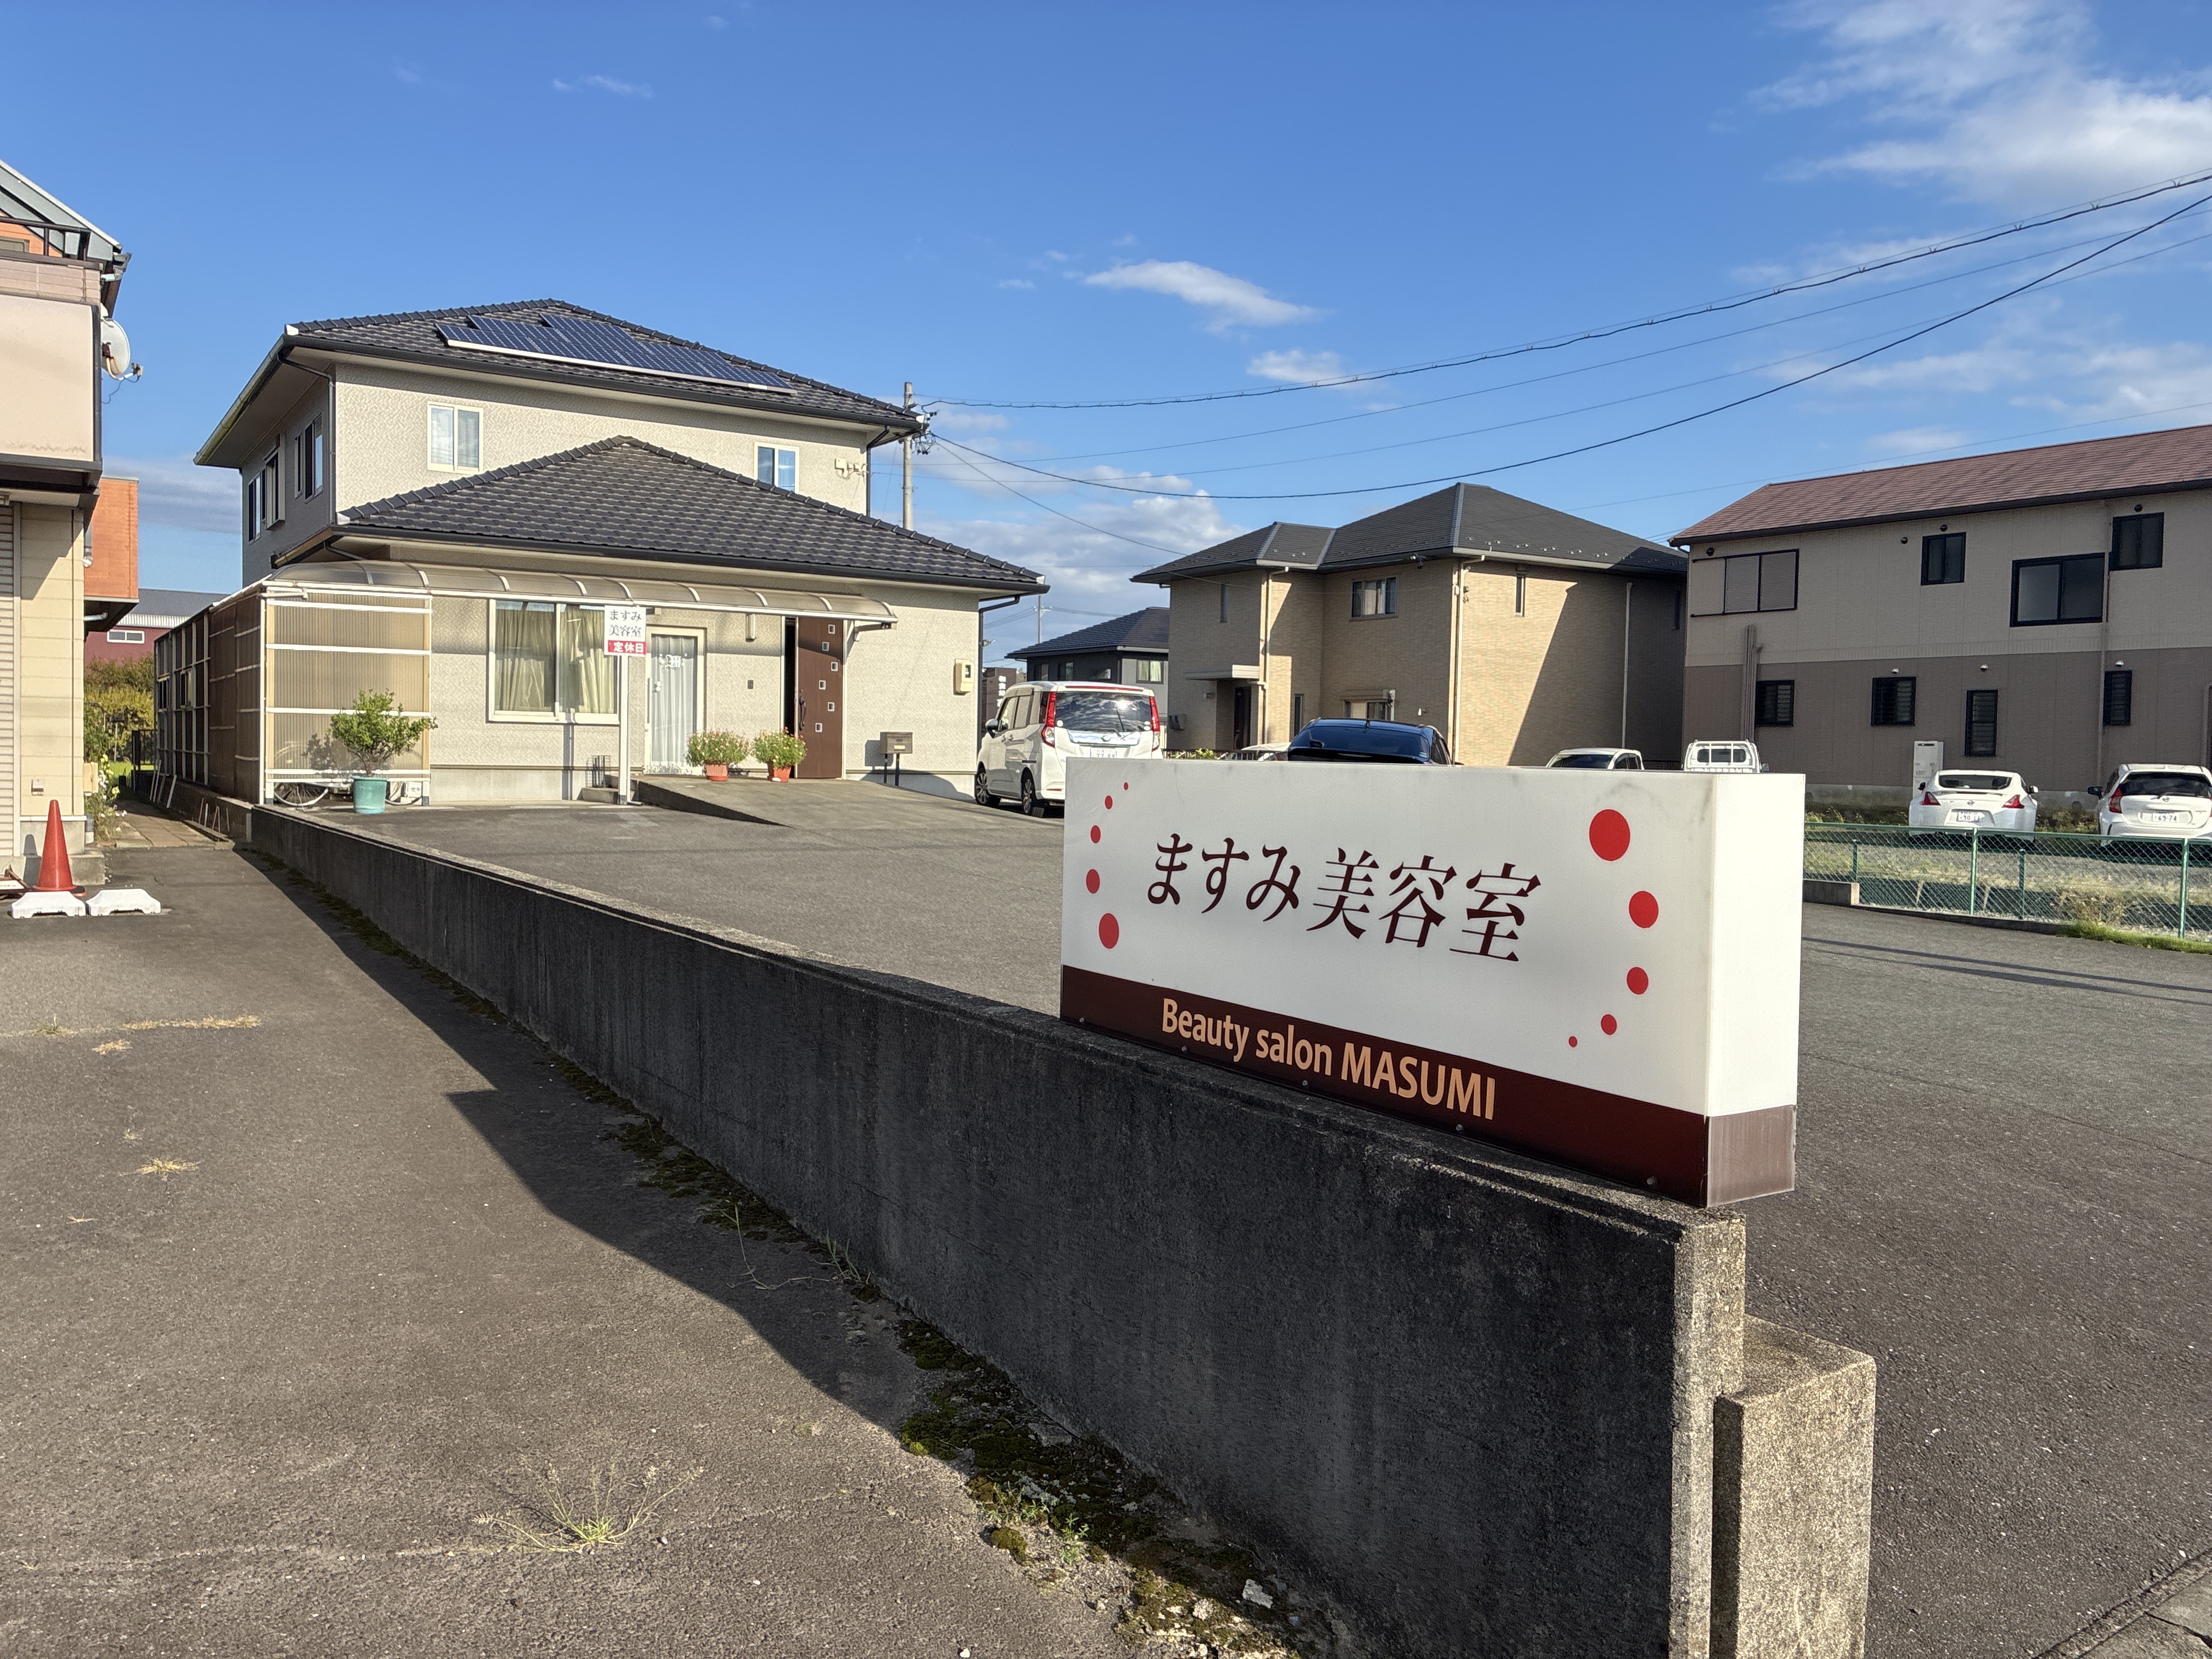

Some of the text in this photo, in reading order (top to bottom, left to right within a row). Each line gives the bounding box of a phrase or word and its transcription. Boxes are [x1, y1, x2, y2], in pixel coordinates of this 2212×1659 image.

[610, 610, 641, 622] ますみ
[613, 641, 644, 653] 定休日
[1147, 833, 1542, 962] ますみ美容室
[1163, 998, 1496, 1120] Beauty salon MASUMI
